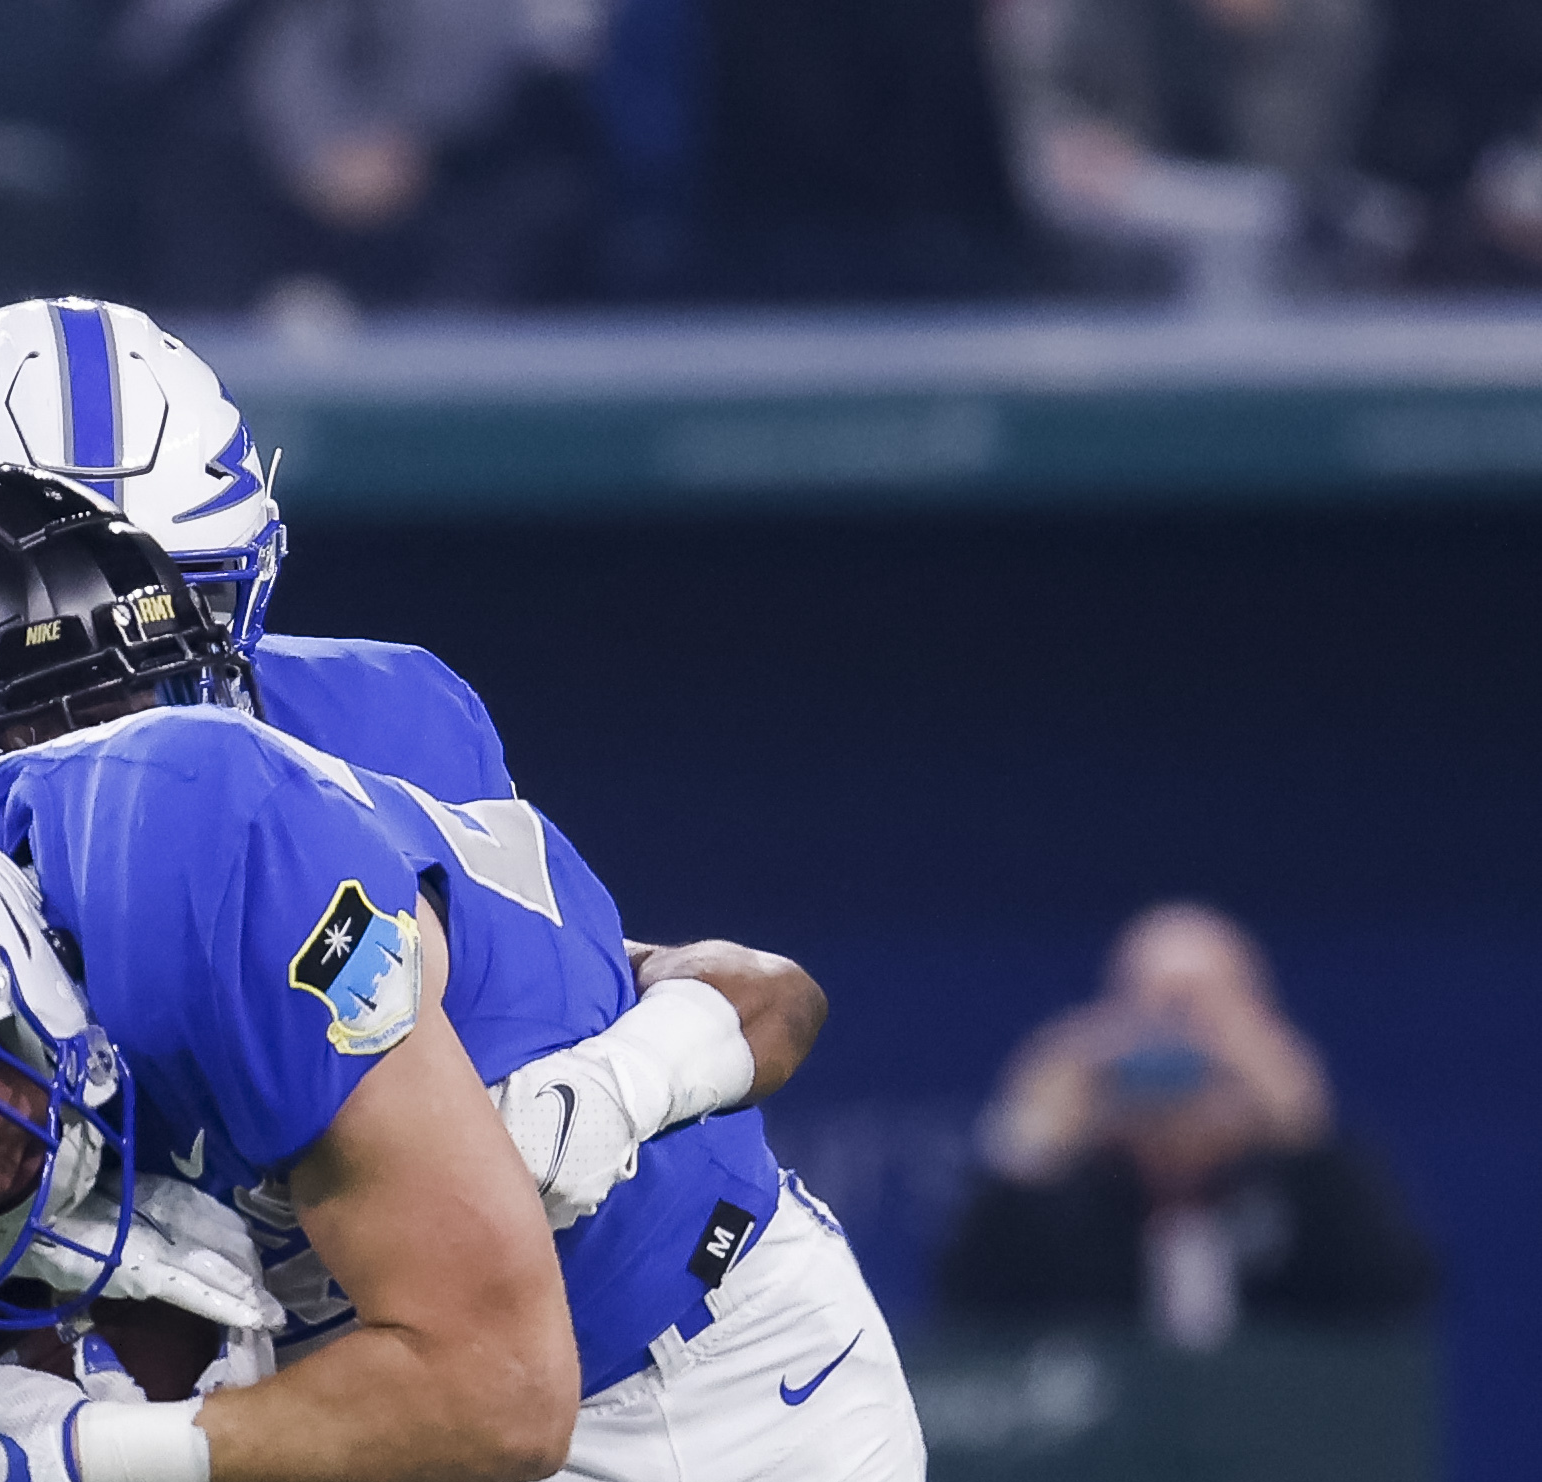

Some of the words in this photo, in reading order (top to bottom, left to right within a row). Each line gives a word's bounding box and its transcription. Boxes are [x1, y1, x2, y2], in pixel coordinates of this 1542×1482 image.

[137, 595, 175, 624] RMY
[25, 620, 62, 647] NIKE
[705, 1226, 736, 1259] M
